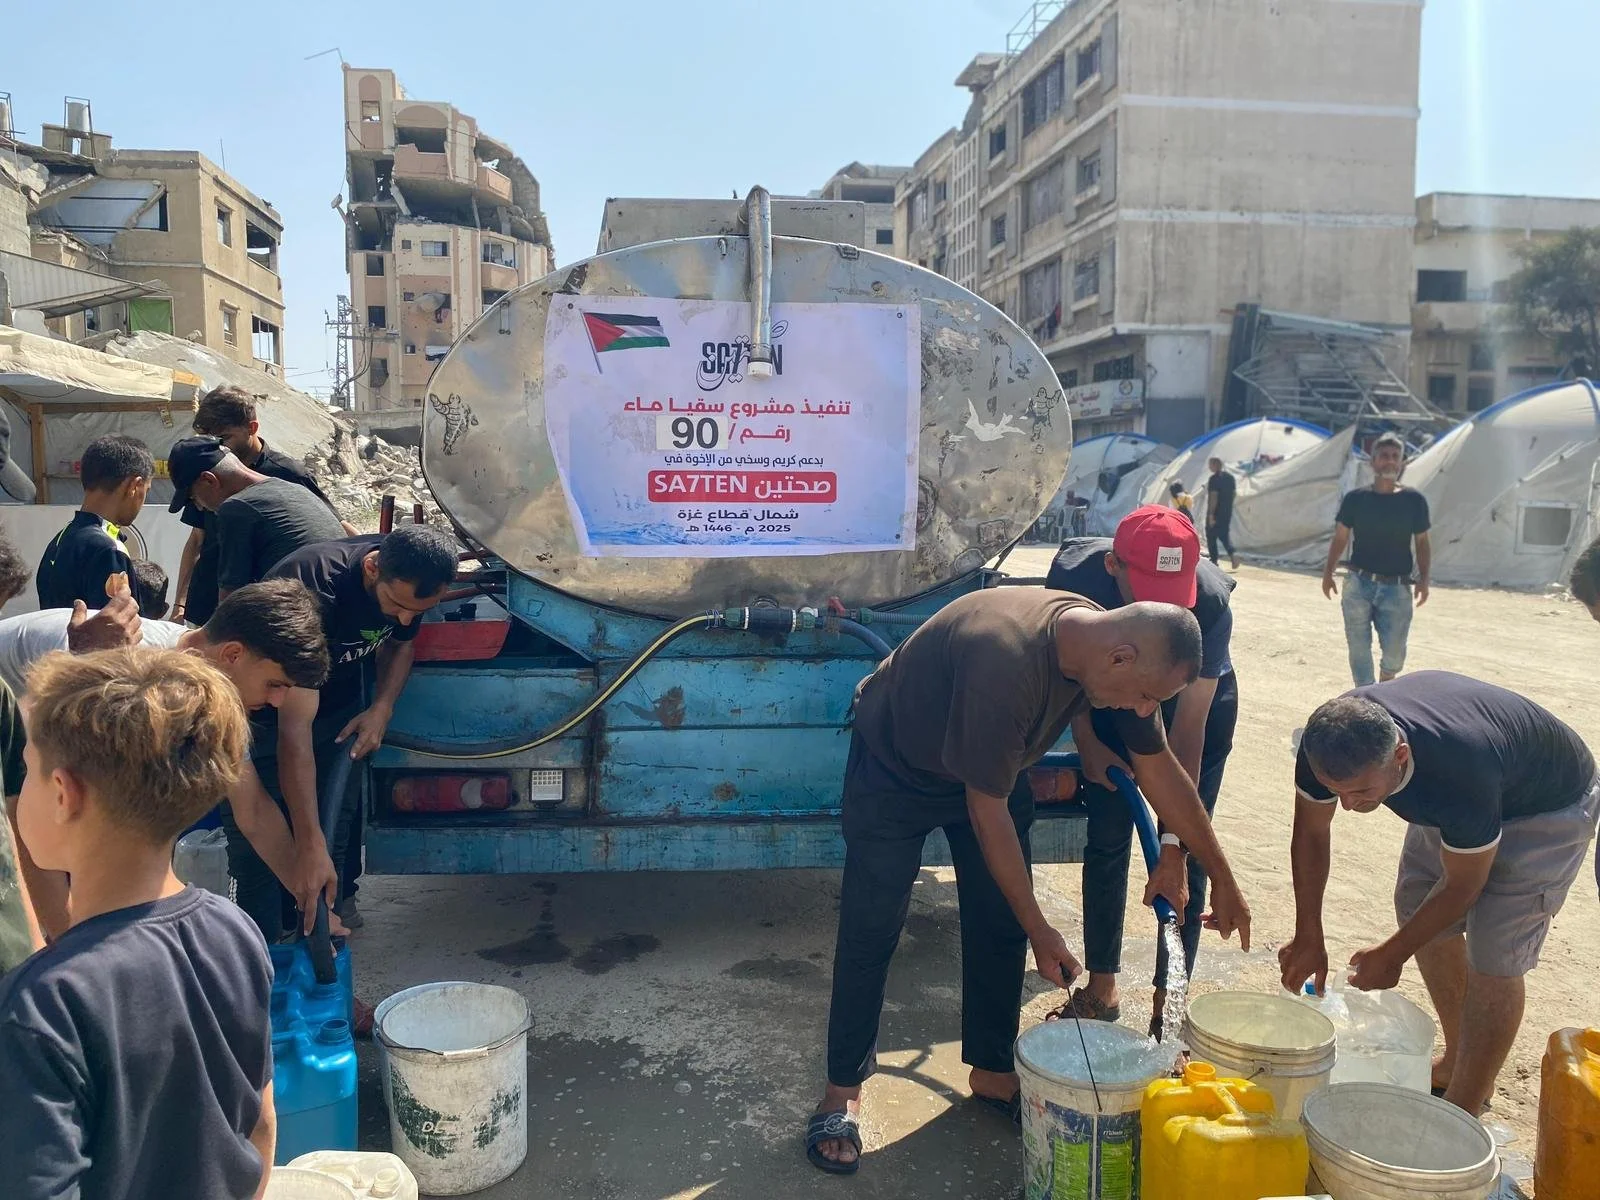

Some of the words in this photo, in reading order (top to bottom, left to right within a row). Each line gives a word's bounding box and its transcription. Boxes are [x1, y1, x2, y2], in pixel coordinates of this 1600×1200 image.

[623, 396, 663, 412] ماء
[669, 397, 724, 417] سقيا
[729, 397, 795, 419] مشروع
[801, 398, 851, 418] تنفيذ
[671, 416, 719, 449] 90
[664, 453, 683, 467] في
[685, 453, 716, 467] الإخوة
[718, 456, 733, 466] من
[735, 454, 770, 468] وسخي
[772, 454, 796, 468] كريم
[798, 455, 824, 468] بدعم
[654, 474, 747, 494] SA7TEN
[754, 475, 831, 499] صحتين
[677, 508, 703, 521] غزة
[707, 508, 749, 523] قطاع
[753, 508, 799, 522] شمال
[703, 524, 732, 532] 1446
[744, 526, 755, 536] م
[758, 524, 791, 533] 2025
